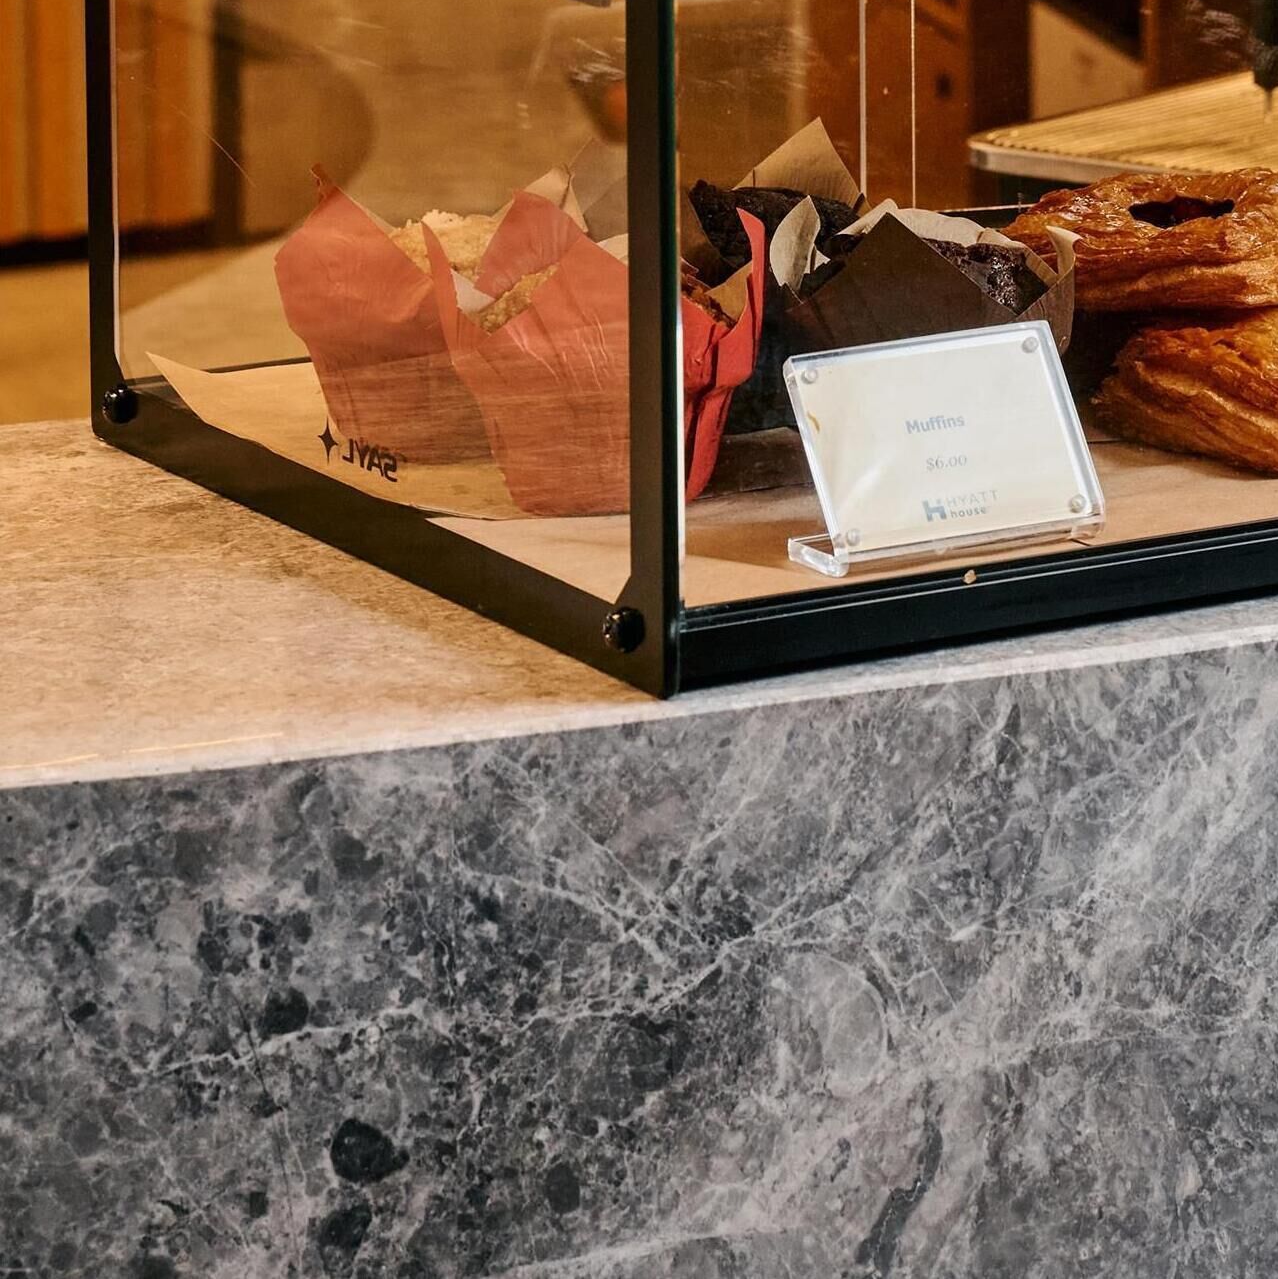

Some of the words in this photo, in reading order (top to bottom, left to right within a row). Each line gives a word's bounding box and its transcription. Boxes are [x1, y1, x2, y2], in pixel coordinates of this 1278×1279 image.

[904, 415, 965, 434] Muffins
[926, 455, 967, 471] $6.00
[946, 489, 999, 508] HYATT
[950, 506, 987, 519] house
